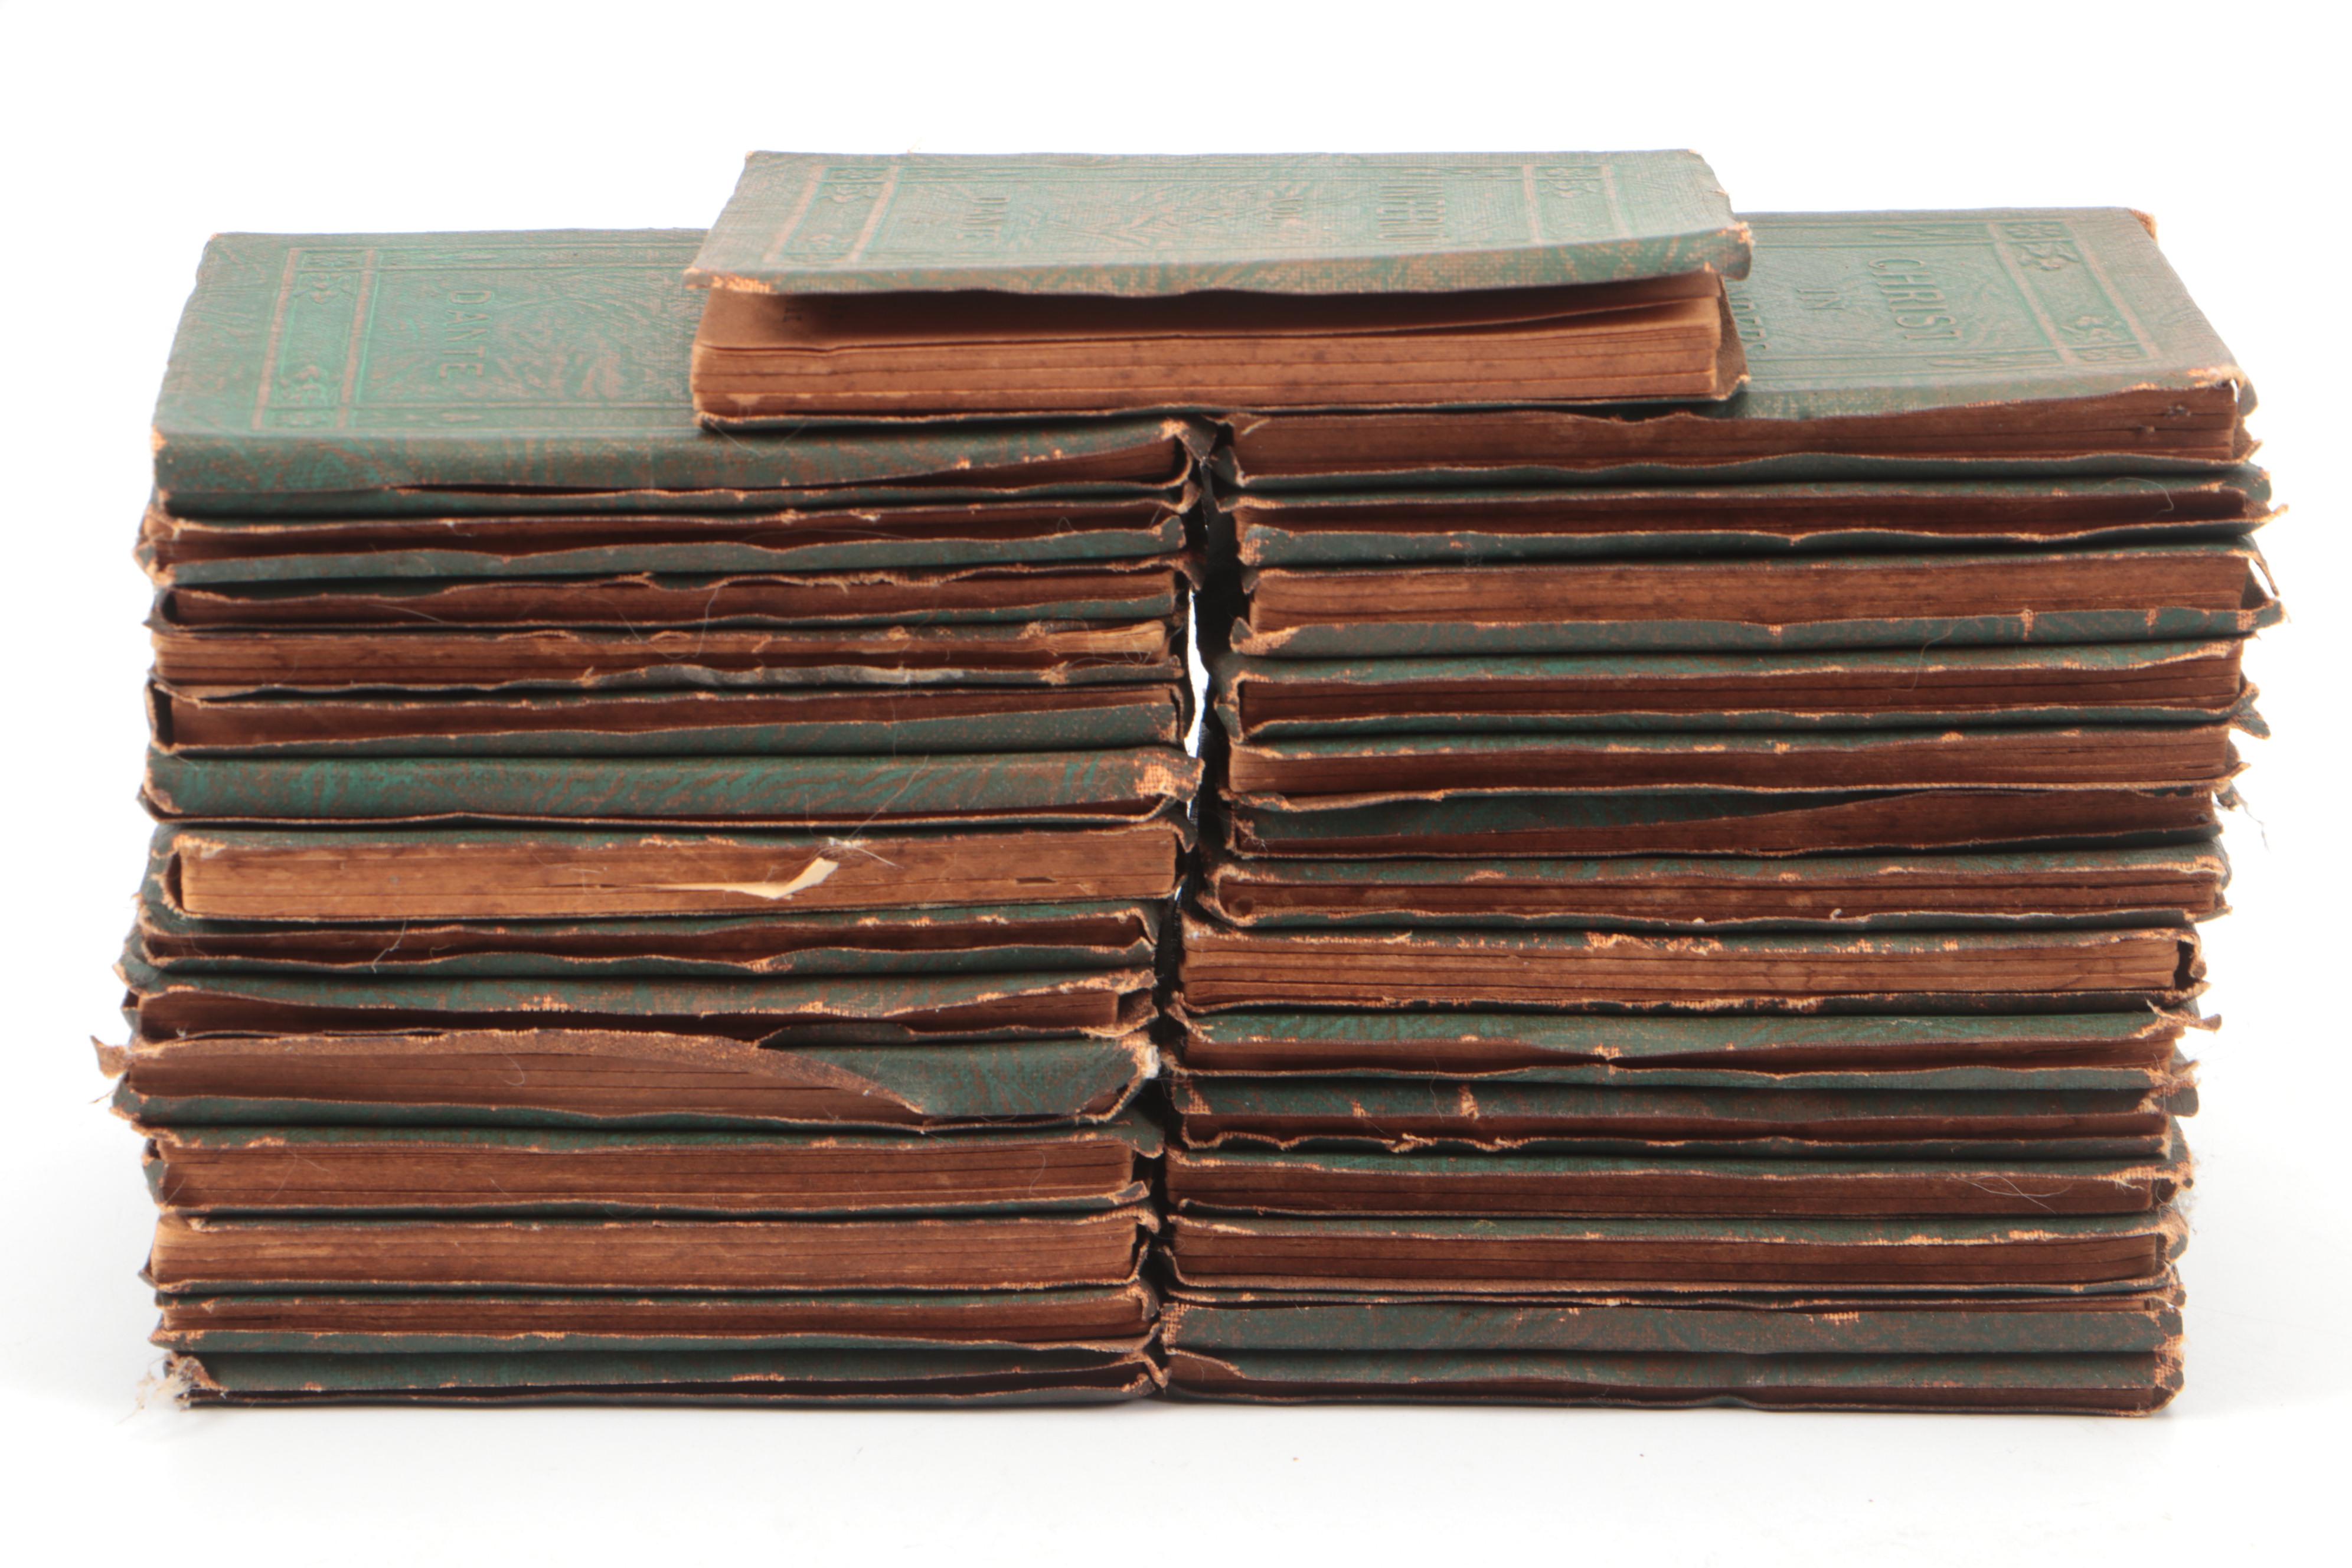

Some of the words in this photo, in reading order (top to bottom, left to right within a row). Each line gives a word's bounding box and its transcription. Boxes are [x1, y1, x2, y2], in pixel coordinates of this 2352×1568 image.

[956, 197, 1010, 240] DANTE
[1796, 288, 1845, 311] IN
[1868, 257, 1962, 341] CHRIST
[438, 290, 492, 378] DANTE
